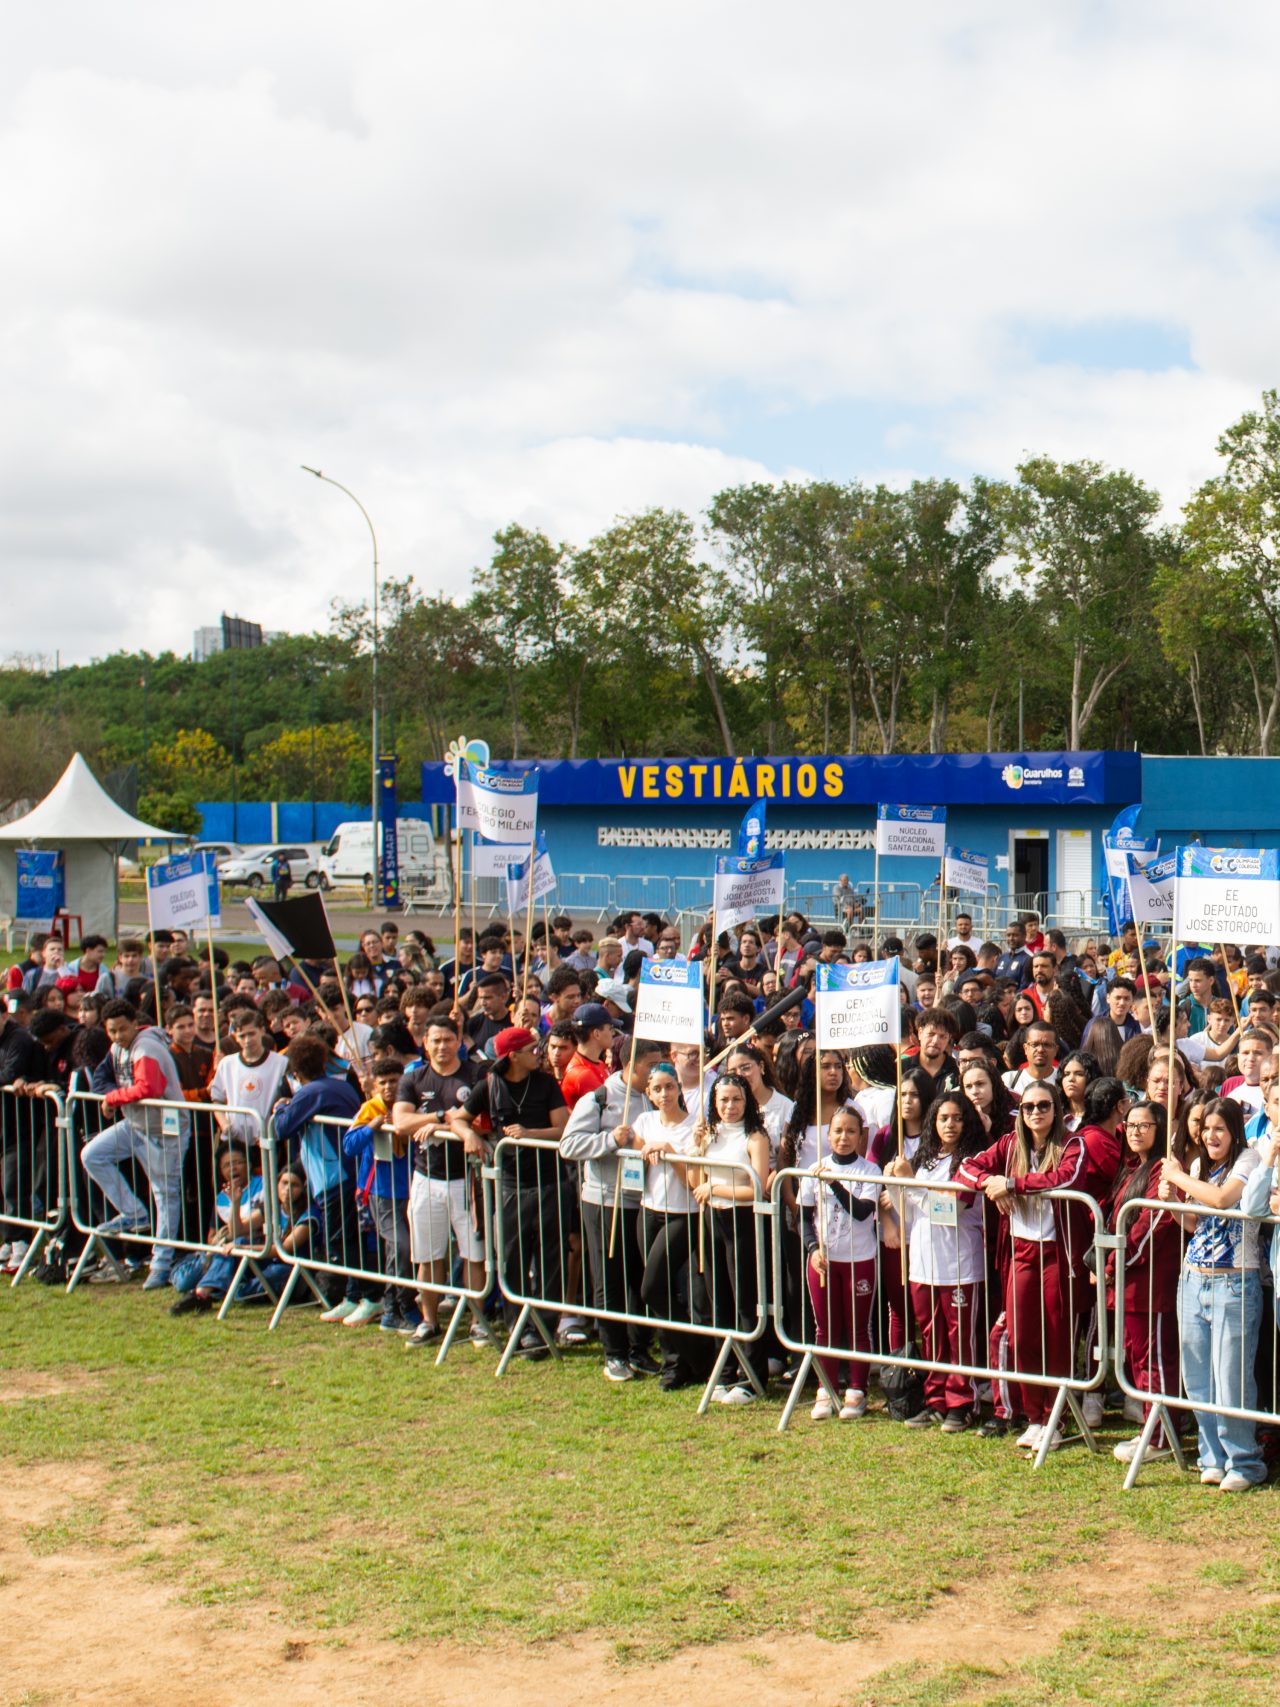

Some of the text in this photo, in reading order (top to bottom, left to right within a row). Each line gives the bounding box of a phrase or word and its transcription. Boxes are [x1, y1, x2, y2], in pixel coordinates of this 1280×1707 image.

[618, 757, 844, 798] VESTIÁRIOS
[1023, 768, 1063, 779] Guarulhos
[460, 806, 535, 831] TERIRO MILÊNI
[899, 827, 928, 836] NÚCLEO
[888, 835, 936, 844] EDUCACIONAL
[385, 827, 396, 867] SMART
[888, 844, 935, 853] SANTA CLARA
[753, 887, 776, 896] COSTA
[1225, 889, 1239, 902] EE
[1204, 904, 1258, 918] DEPUTADO
[831, 1007, 886, 1025] EDUCACAL
[829, 1021, 888, 1038] GERAÇ 000
